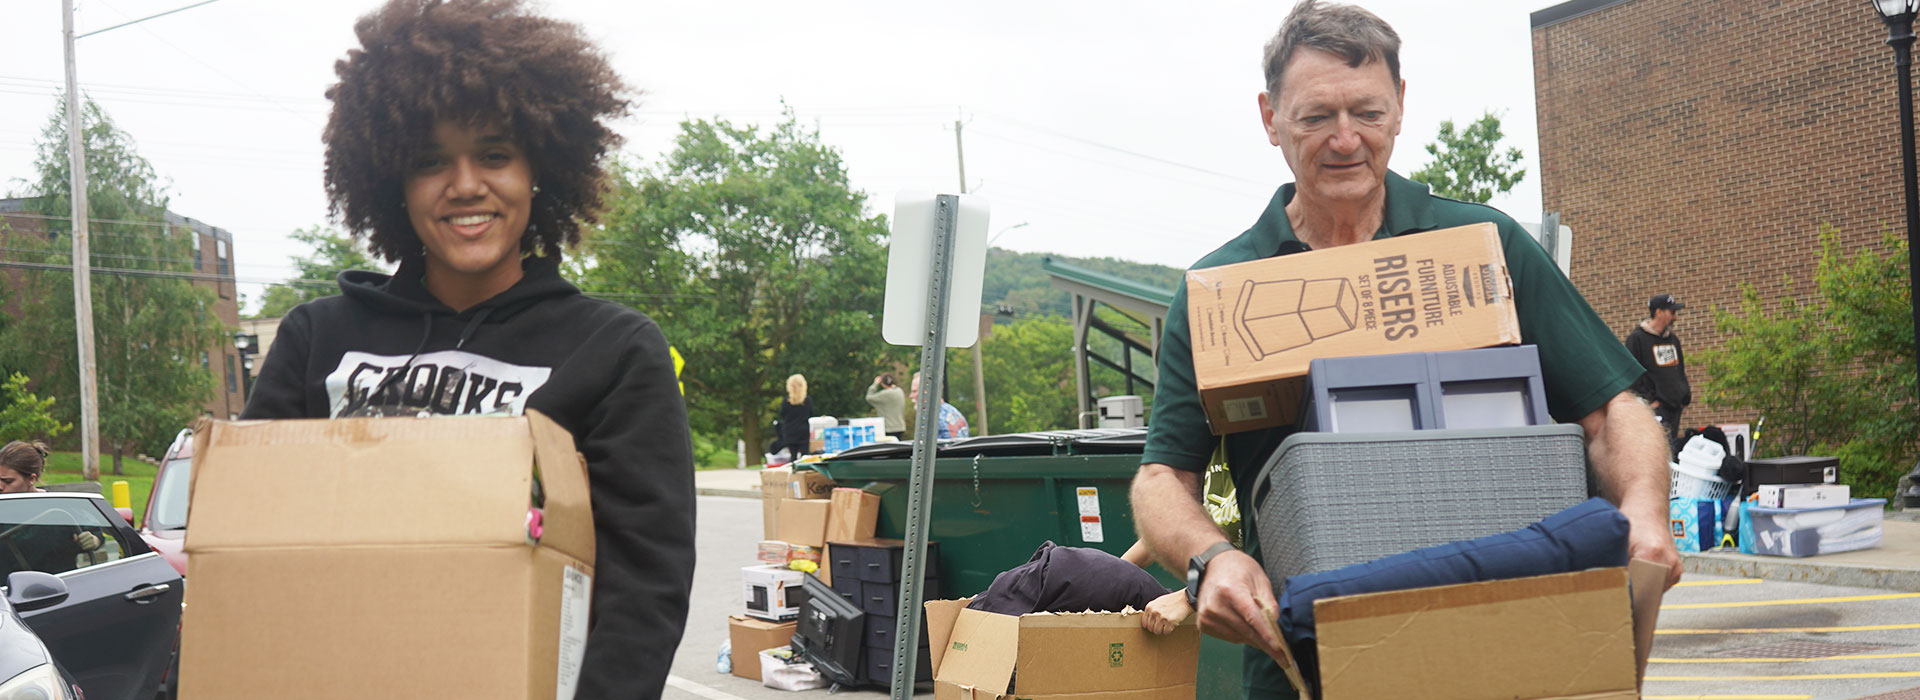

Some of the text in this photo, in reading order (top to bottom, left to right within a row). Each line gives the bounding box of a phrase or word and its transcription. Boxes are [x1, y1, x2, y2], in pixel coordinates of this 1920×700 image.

[1358, 274, 1371, 288] SET
[1360, 289, 1373, 300] OF
[1373, 254, 1419, 342] RISERS
[1416, 258, 1444, 328] FURNITURE
[1442, 264, 1463, 317] ADJUSTABLE
[1363, 308, 1378, 331] PIECE
